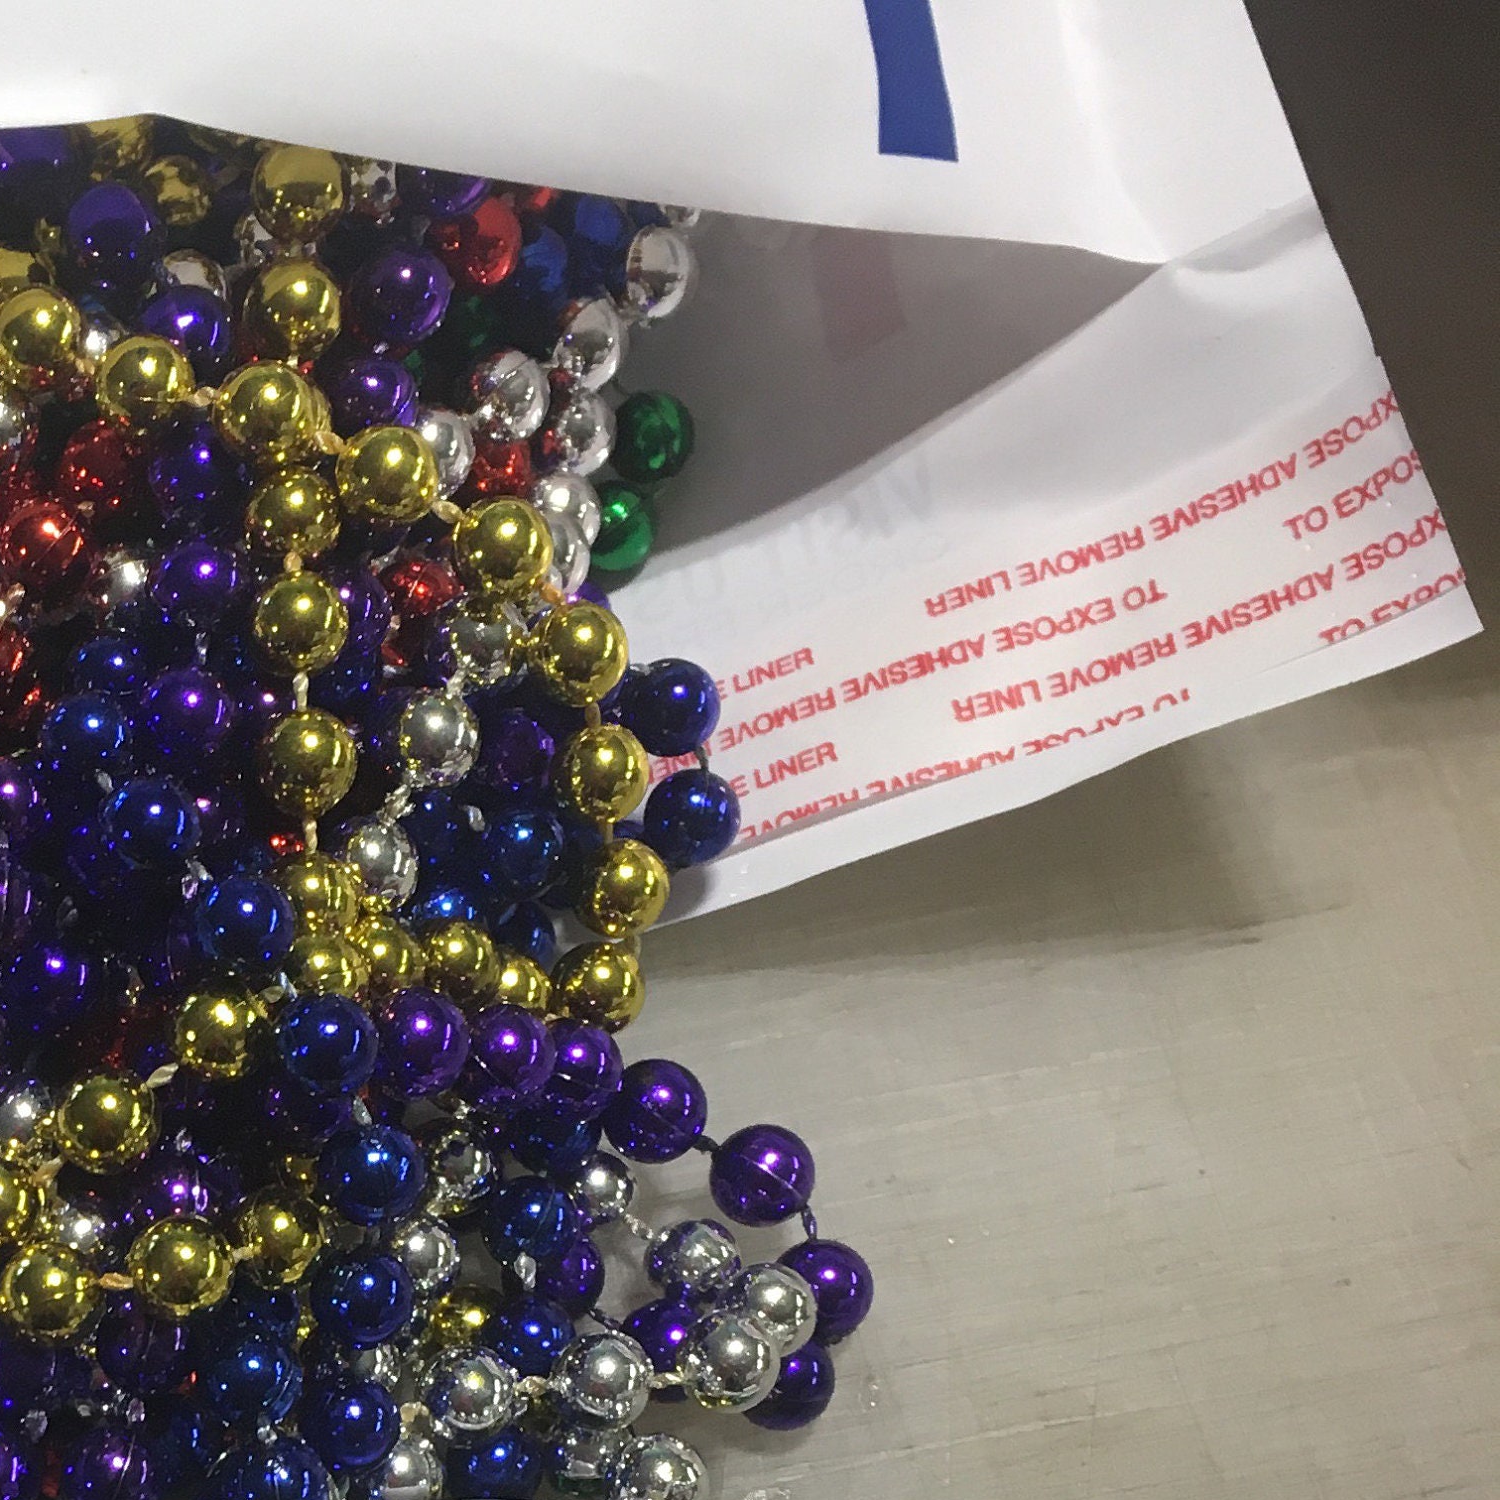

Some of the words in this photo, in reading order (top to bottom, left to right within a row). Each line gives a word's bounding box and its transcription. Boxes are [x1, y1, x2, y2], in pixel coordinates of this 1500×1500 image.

[1303, 390, 1399, 468] XPOSE
[1149, 452, 1297, 541] ADHESIVE
[1283, 505, 1328, 540] TO
[1332, 449, 1422, 519] EXPO
[1015, 526, 1145, 587] REMOVE
[1341, 507, 1447, 581] XPOSE
[925, 571, 1012, 617] LINER
[992, 597, 1116, 652] EXPOSE
[1122, 578, 1168, 611] TO
[1181, 564, 1334, 648] ADHESIVE
[733, 647, 815, 693] LINER
[843, 633, 985, 704] ADHESIVE
[1047, 633, 1178, 698] REMOVE
[717, 687, 837, 751] REMOVE
[952, 680, 1042, 723] LINER
[754, 742, 838, 789] LINER
